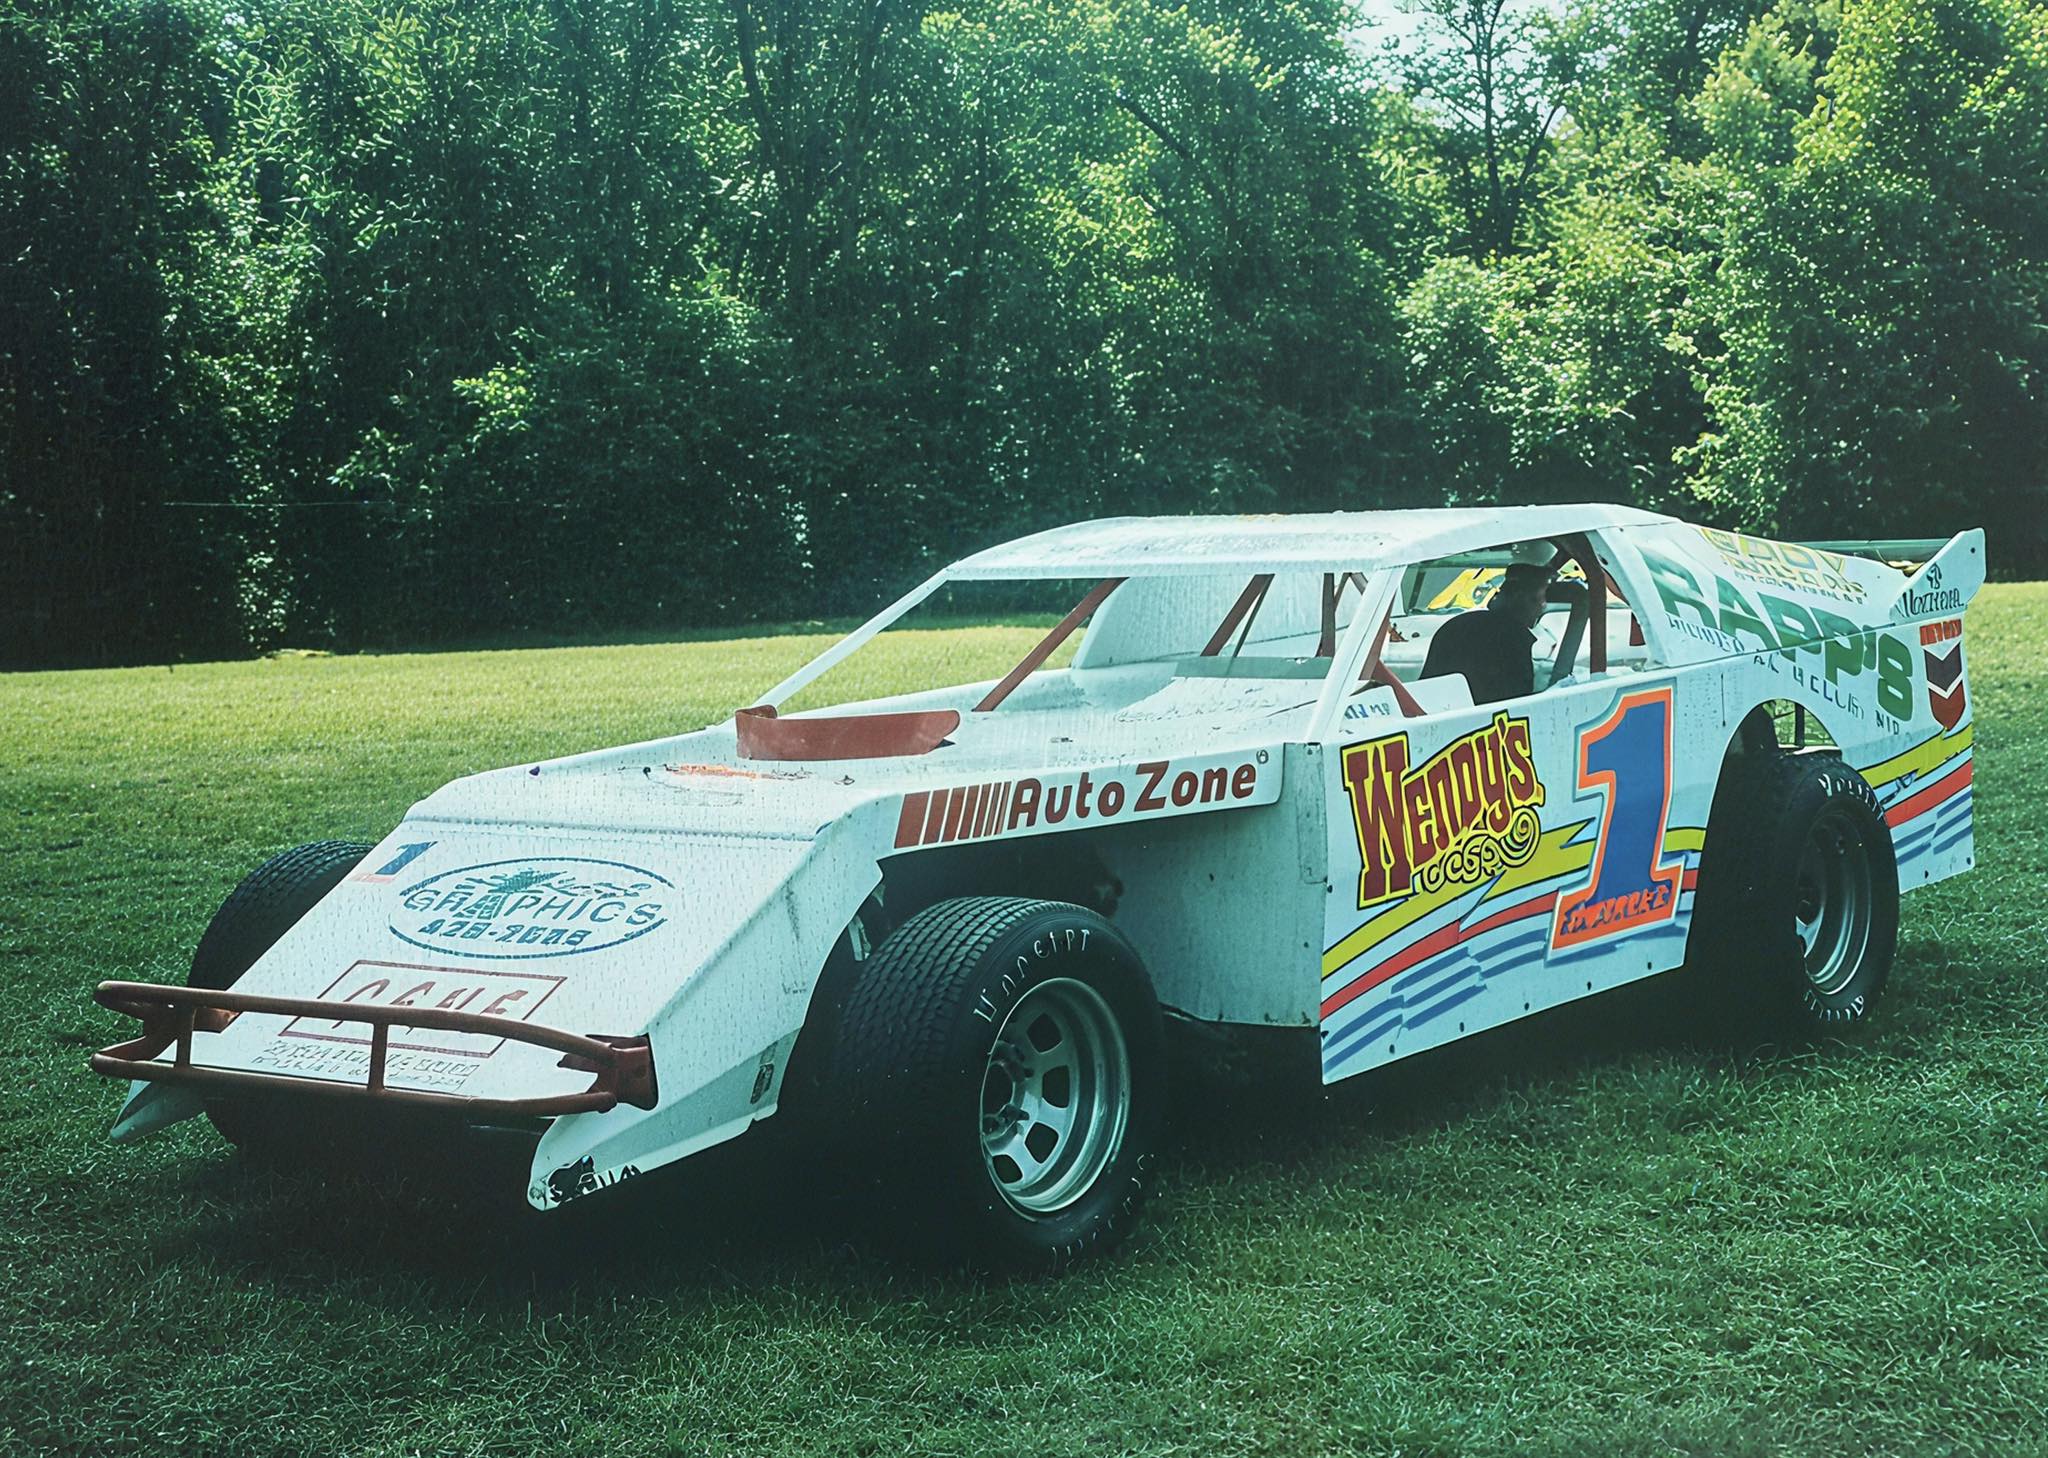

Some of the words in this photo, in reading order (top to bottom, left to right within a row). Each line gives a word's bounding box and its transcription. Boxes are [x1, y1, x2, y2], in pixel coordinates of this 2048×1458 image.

[1553, 686, 1684, 950] 1
[375, 841, 438, 875] 1
[403, 888, 663, 927] GRAPHICS
